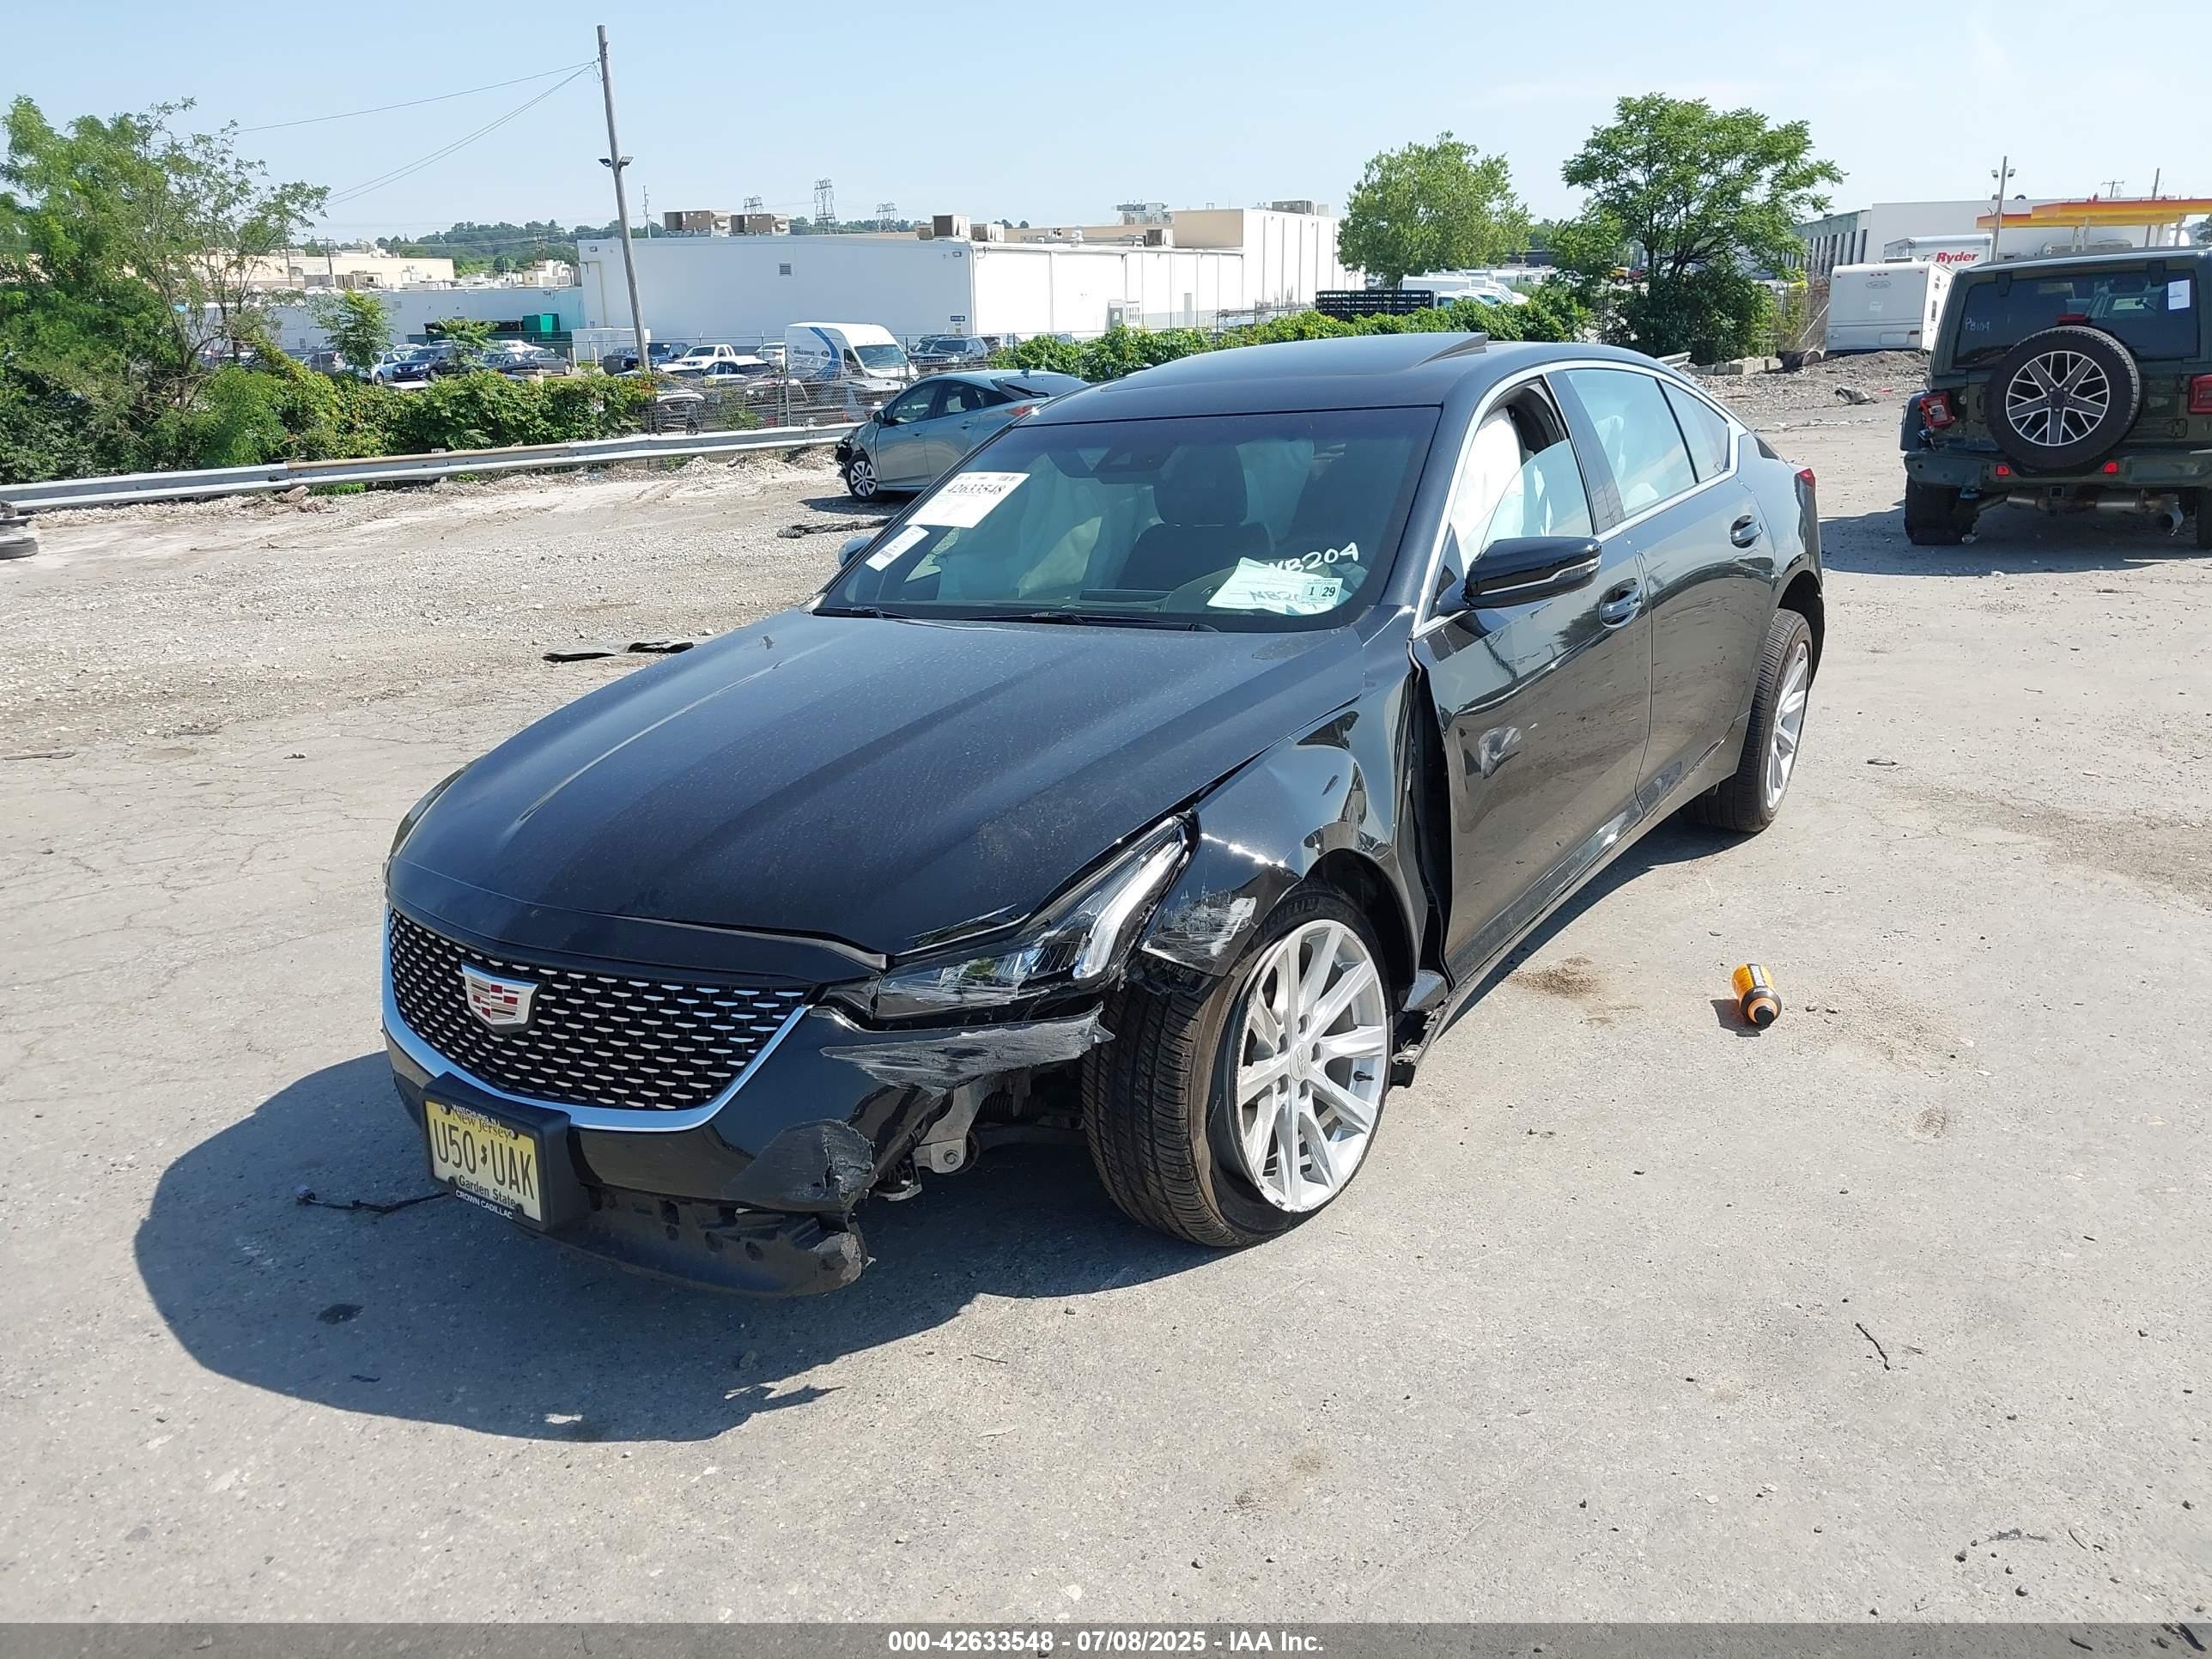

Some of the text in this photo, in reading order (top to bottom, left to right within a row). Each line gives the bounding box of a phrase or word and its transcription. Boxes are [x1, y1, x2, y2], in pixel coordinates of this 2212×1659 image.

[1936, 251, 1979, 264] Ryder
[946, 483, 1004, 495] 42633548
[1267, 541, 1359, 575] NB204
[1307, 586, 1336, 598] 1 29
[452, 1109, 510, 1142] New Jersey
[433, 1118, 535, 1200] U50 UAK
[455, 1189, 514, 1219] CROWN CADILLAC
[459, 1174, 516, 1208] Garden State
